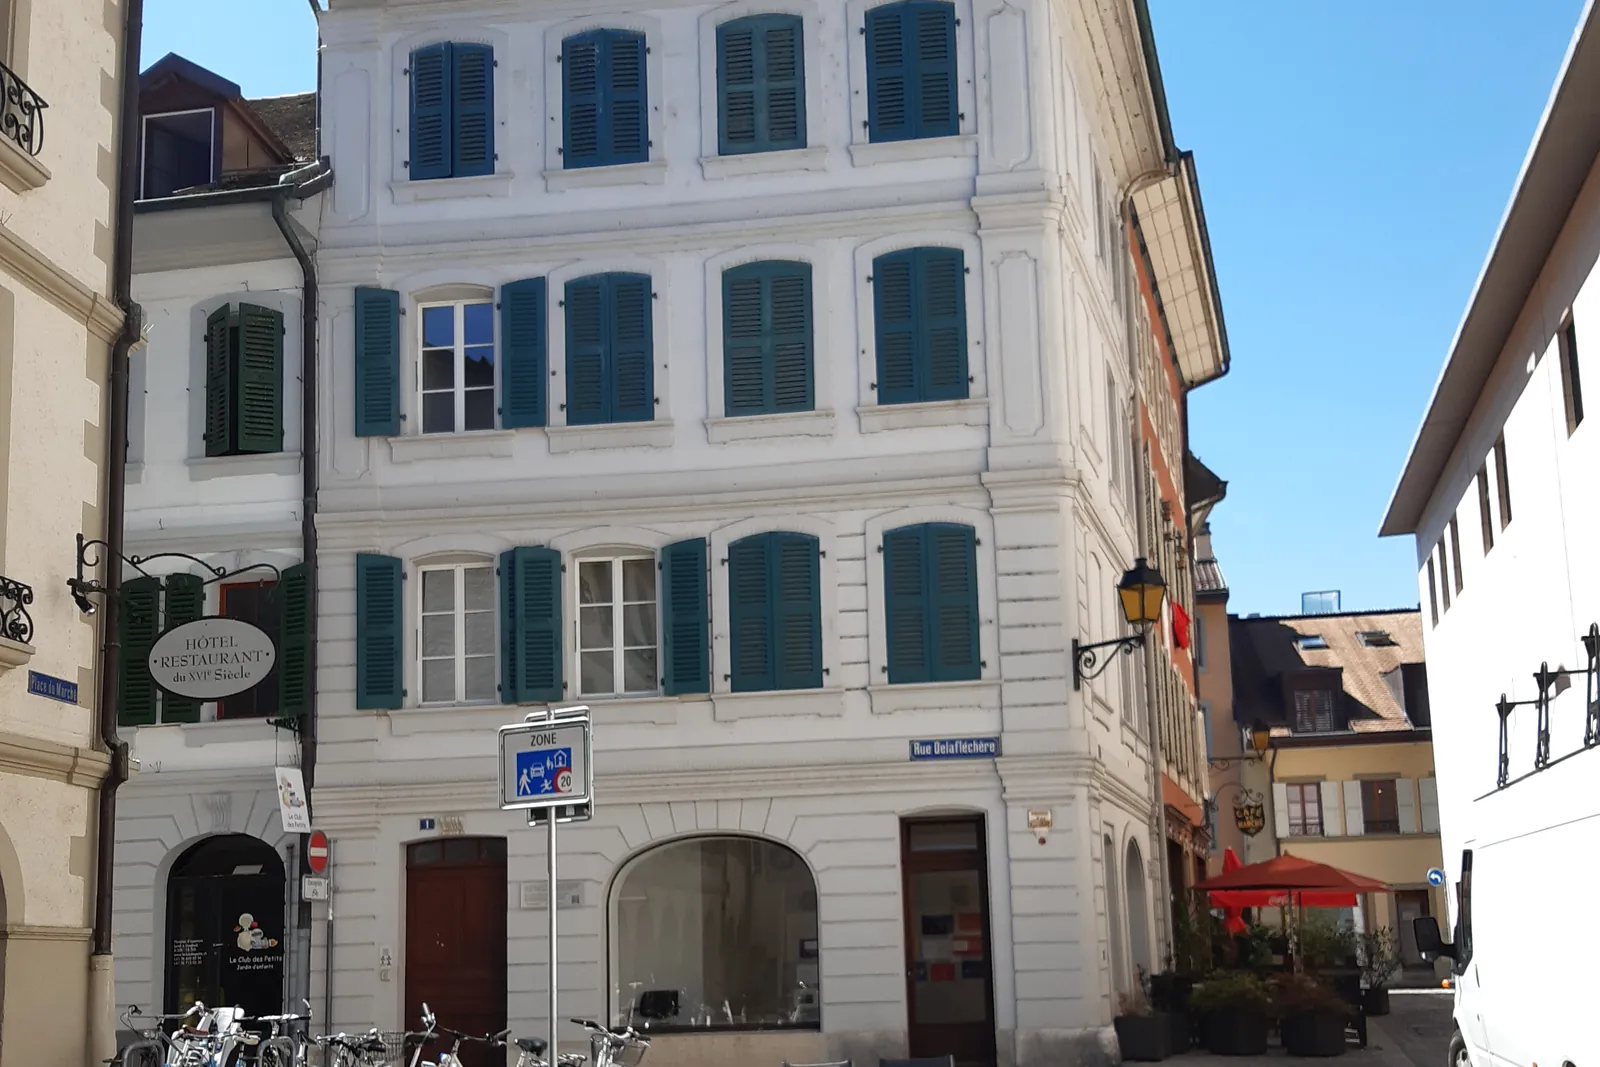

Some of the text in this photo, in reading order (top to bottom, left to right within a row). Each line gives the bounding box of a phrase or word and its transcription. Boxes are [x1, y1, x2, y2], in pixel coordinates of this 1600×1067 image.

[185, 635, 238, 650] HÔTEL
[161, 650, 263, 668] RESTAURANT
[172, 672, 186, 682] du
[214, 665, 251, 681] Siècle
[31, 676, 47, 692] Place
[48, 680, 55, 695] du
[530, 732, 557, 747] ZONE
[913, 742, 932, 755] Rue
[561, 775, 571, 787] 20
